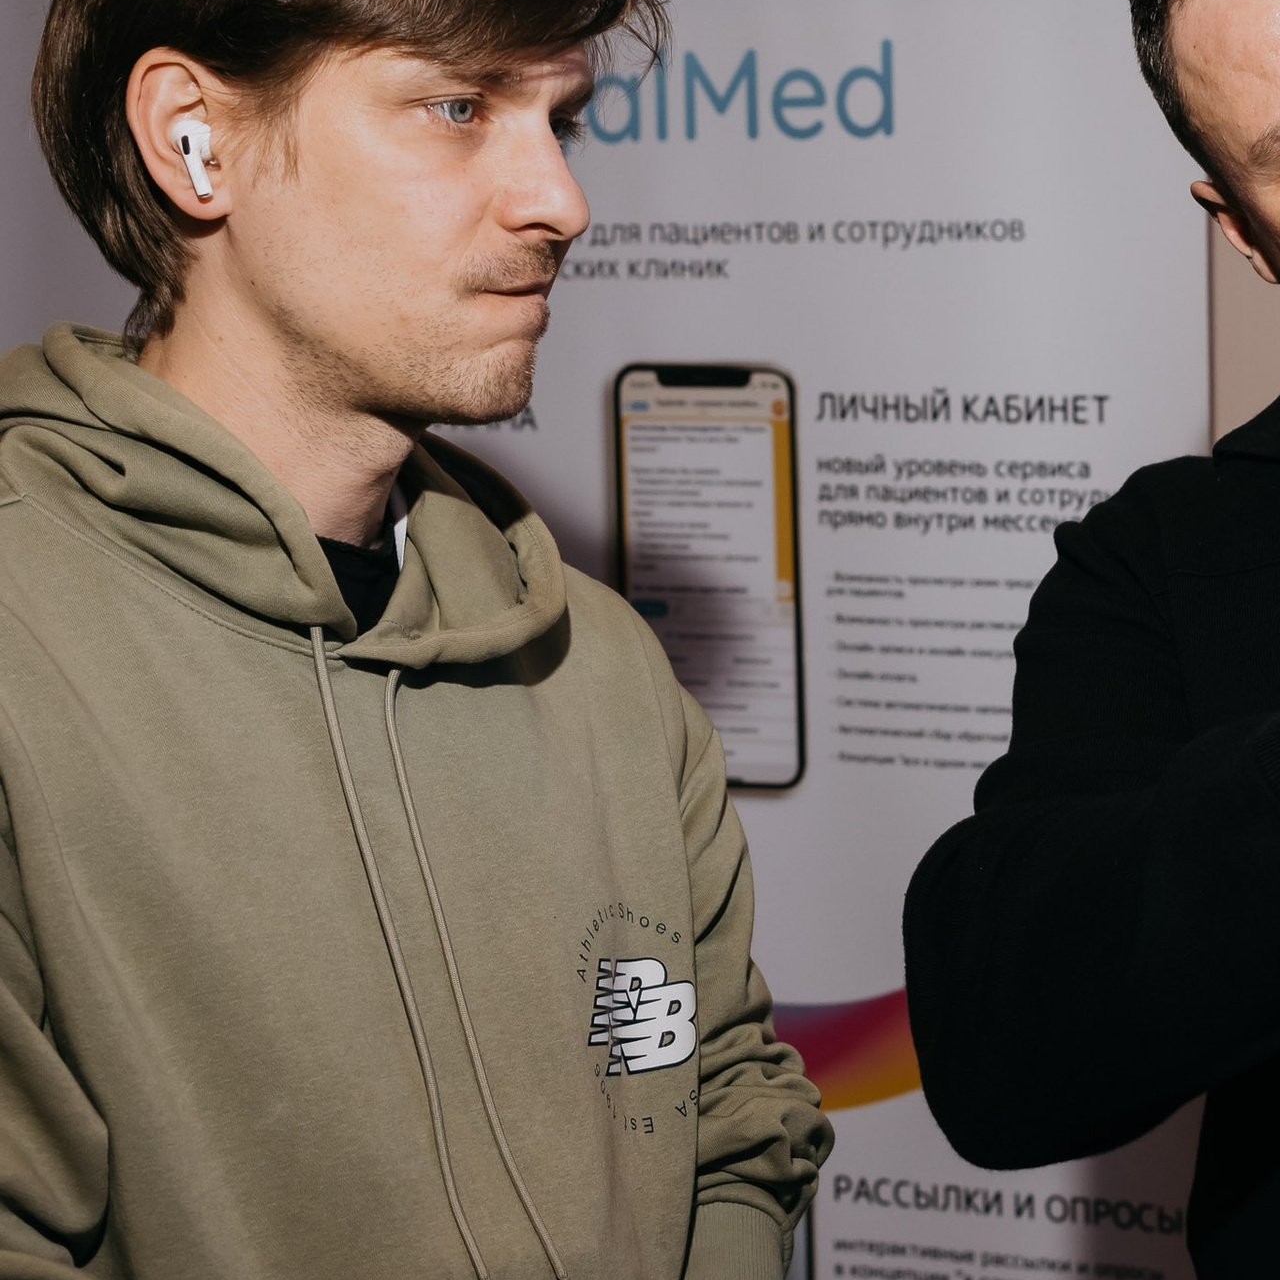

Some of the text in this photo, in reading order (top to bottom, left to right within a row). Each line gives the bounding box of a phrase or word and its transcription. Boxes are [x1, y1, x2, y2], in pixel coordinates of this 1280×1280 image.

[563, 38, 894, 149] alMed
[589, 218, 1026, 250] для пациентов и сотрудников
[626, 258, 730, 281] клиник
[816, 387, 1110, 425] ЛИЧНЫЙ КАБИНЕТ
[816, 453, 1092, 481] новый уровень сервиса
[817, 484, 860, 503] для
[864, 484, 988, 506] пациентов
[996, 487, 1009, 504] и
[818, 509, 887, 530] прямо
[893, 511, 977, 534] внутри
[576, 902, 683, 983] Athletic Shoes
[833, 1174, 1184, 1237] РАССЫЛКИ И ОПРОСЫ
